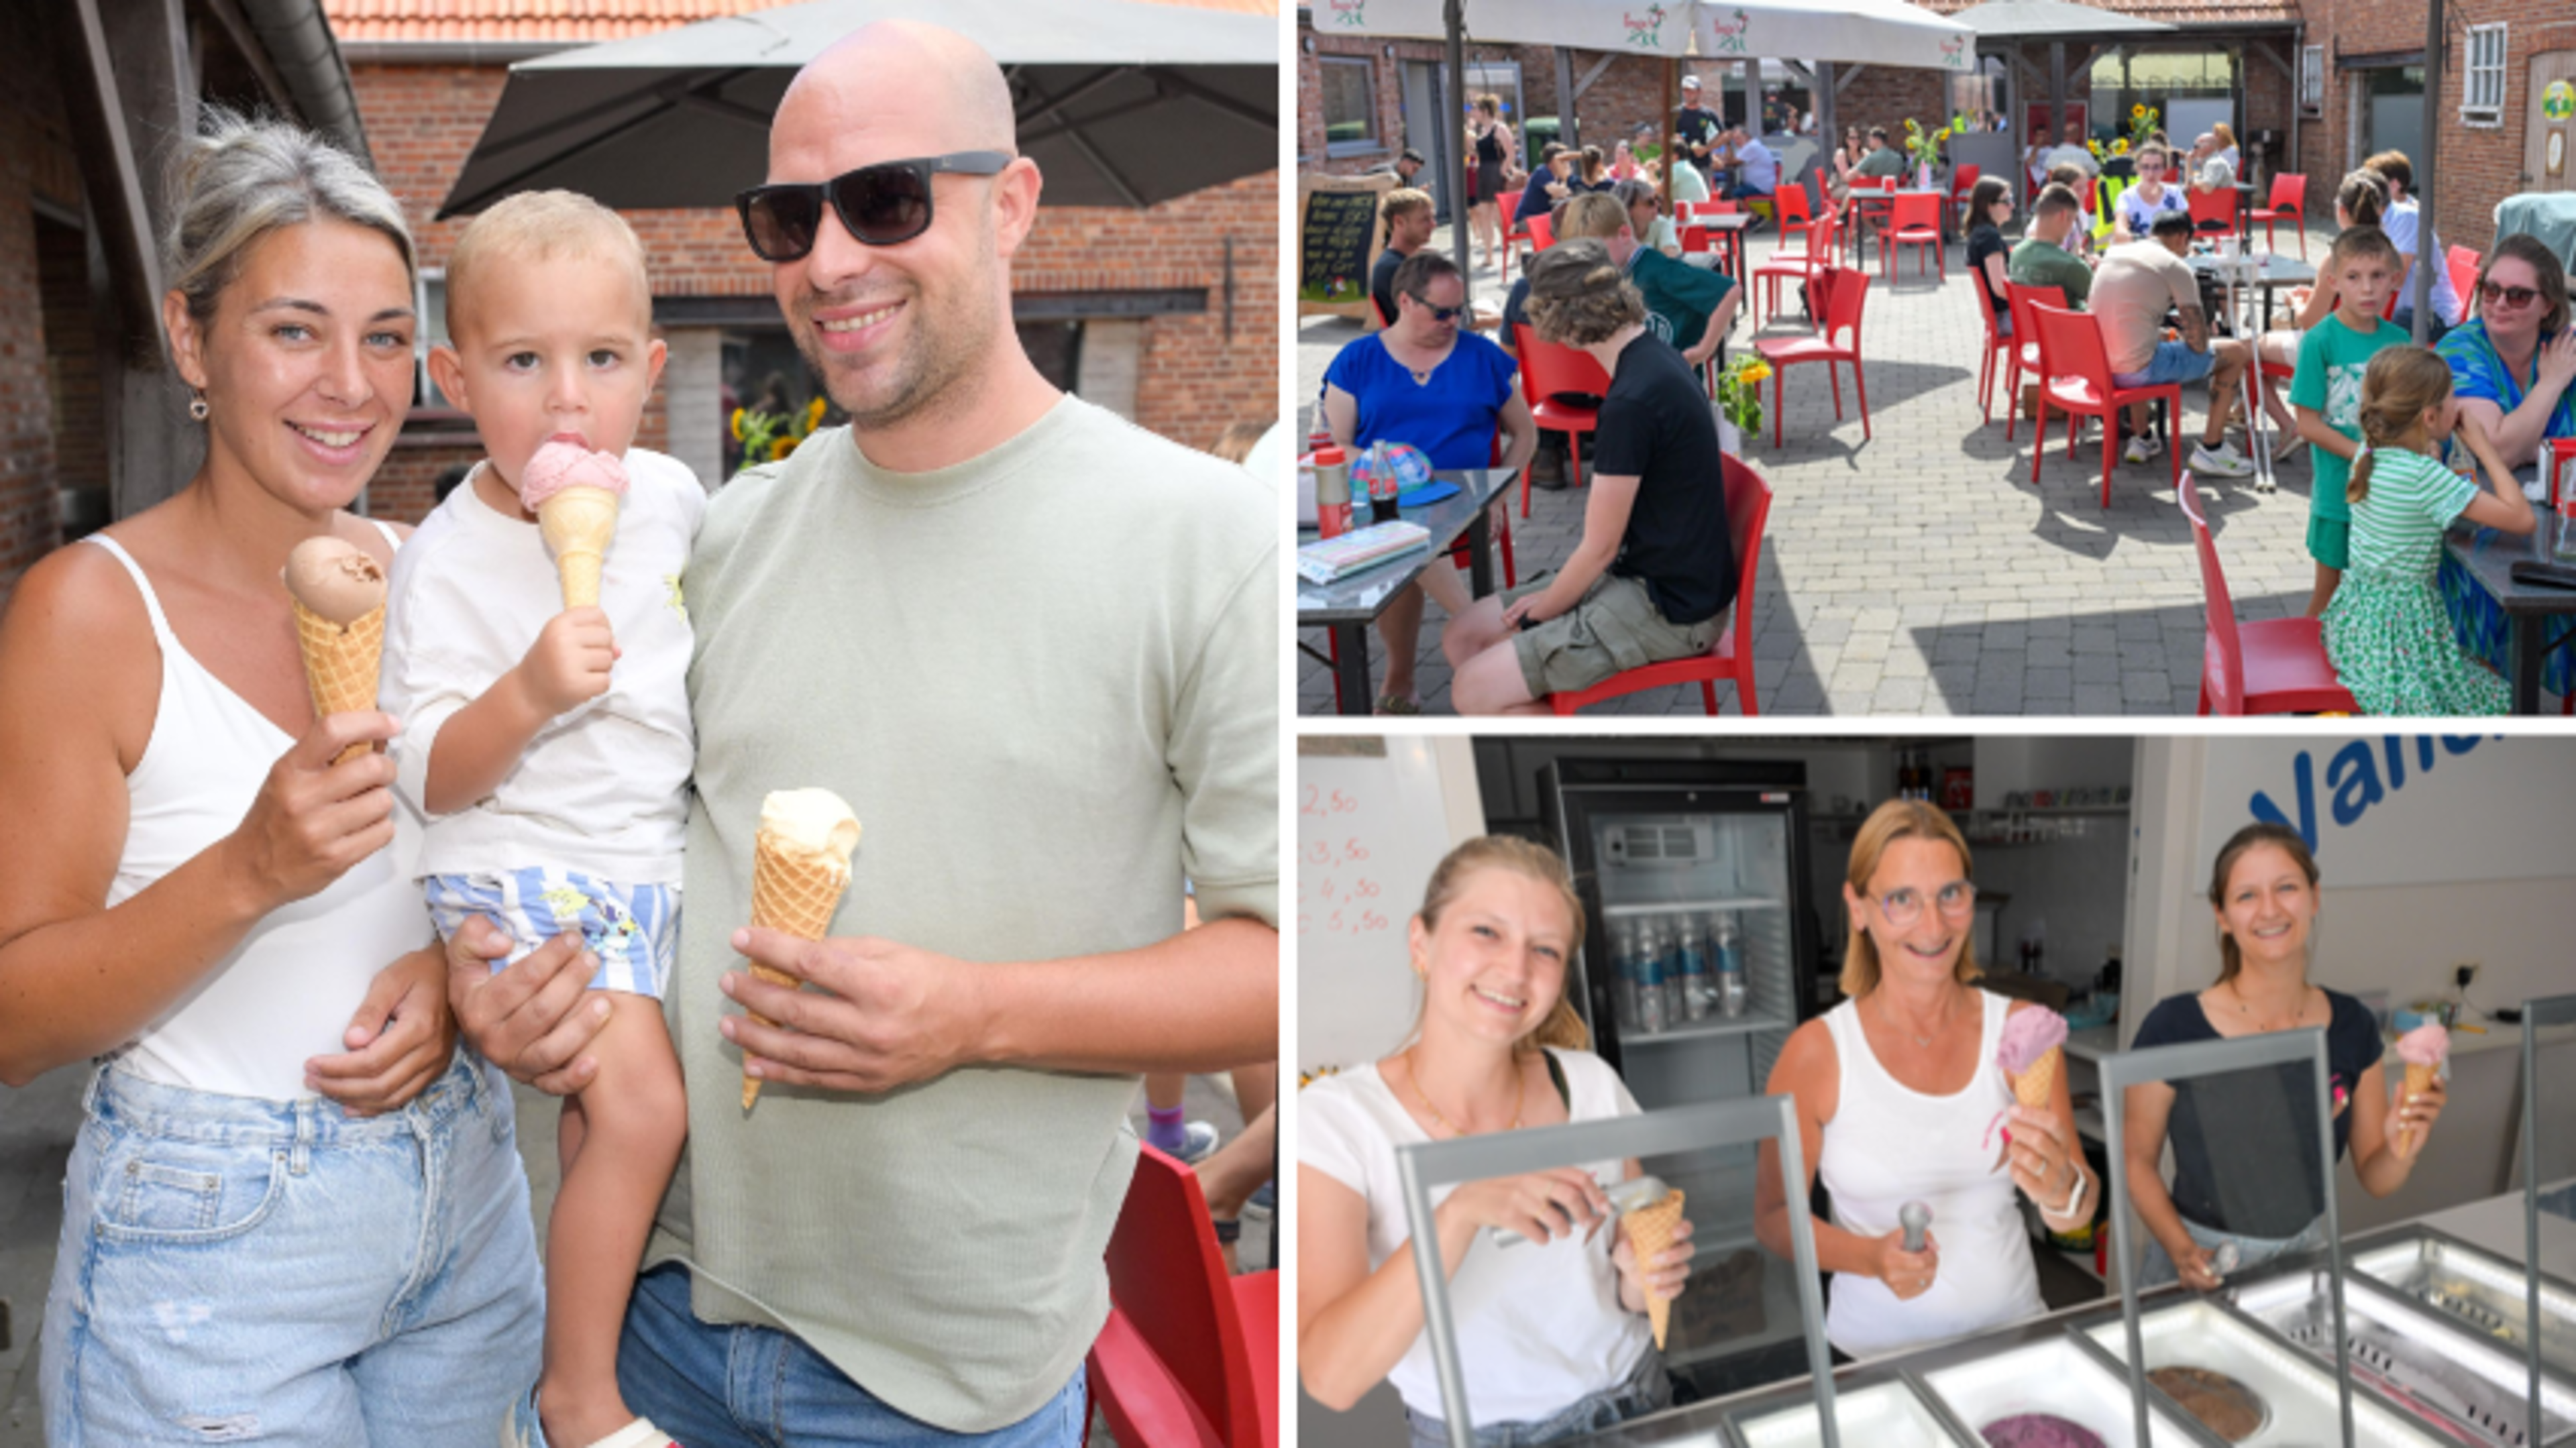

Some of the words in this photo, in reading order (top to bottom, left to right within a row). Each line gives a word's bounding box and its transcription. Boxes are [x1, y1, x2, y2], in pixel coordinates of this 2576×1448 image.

[1299, 783, 1358, 818] 2,50
[1307, 836, 1371, 869] 3,50
[1320, 877, 1381, 905] 4,50
[1327, 908, 1389, 936] 5,50
